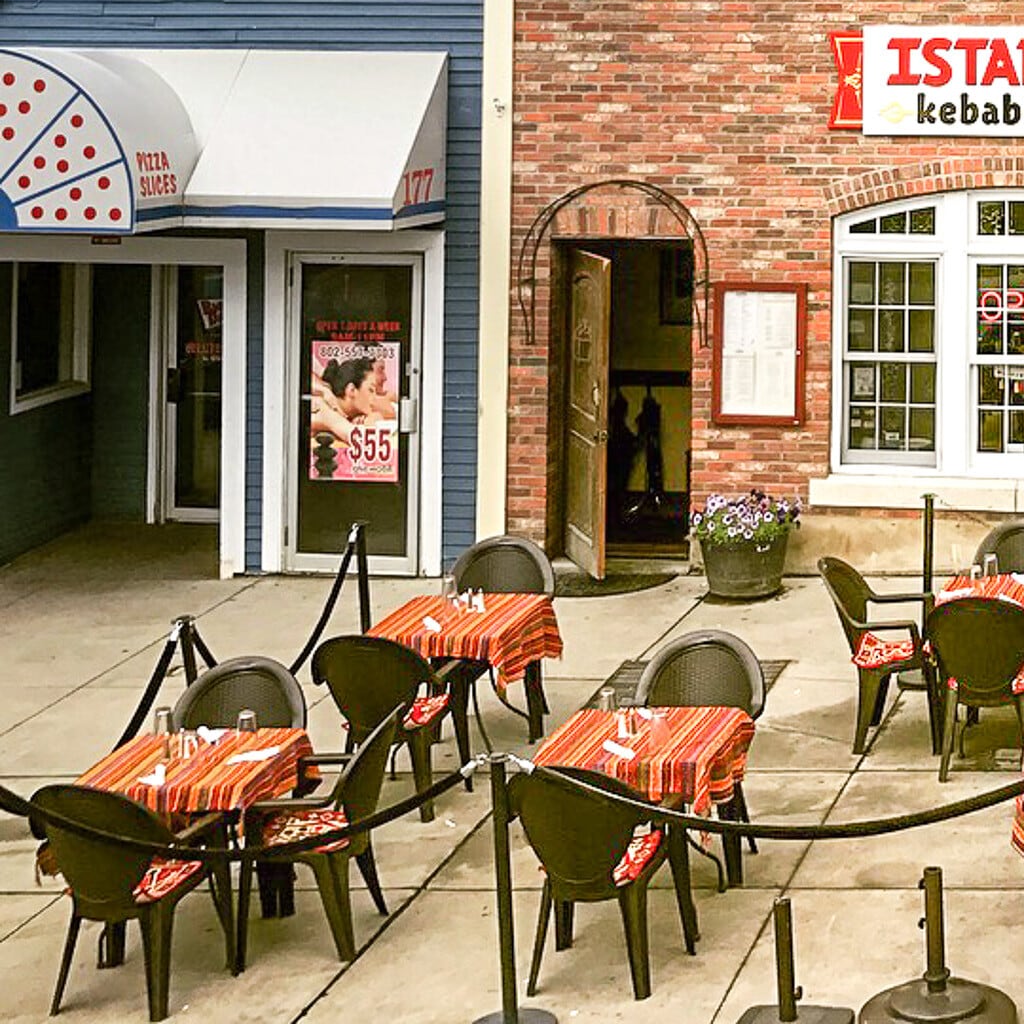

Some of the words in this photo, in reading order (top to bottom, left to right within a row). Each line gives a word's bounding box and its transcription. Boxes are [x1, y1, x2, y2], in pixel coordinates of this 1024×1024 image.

[916, 93, 1022, 126] kebab
[135, 151, 170, 172] PIZZA
[140, 173, 178, 197] SLICES
[402, 168, 434, 206] 177
[349, 426, 391, 464] $55
